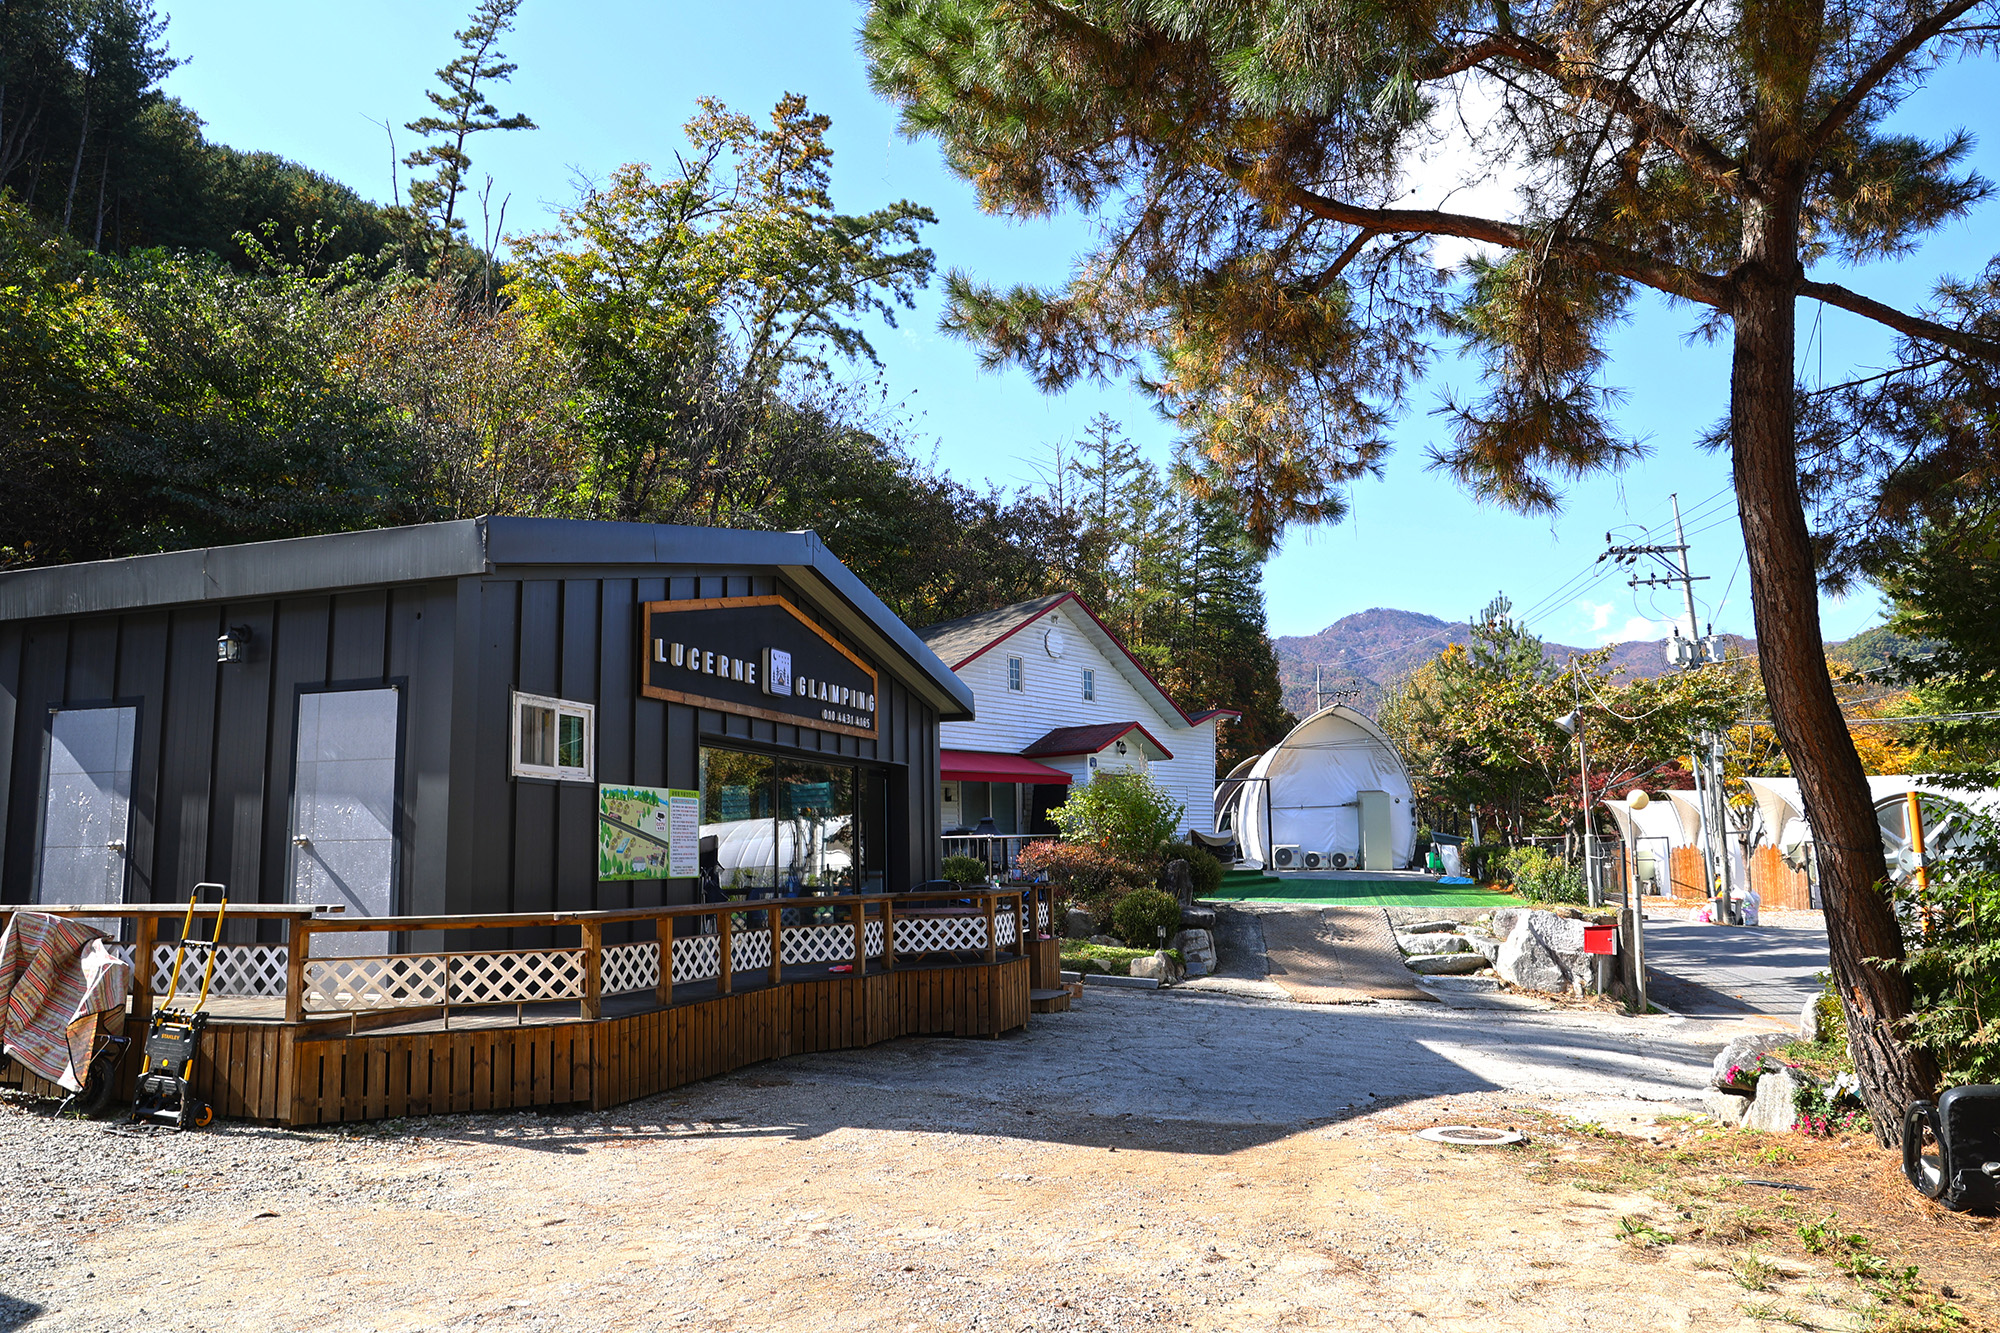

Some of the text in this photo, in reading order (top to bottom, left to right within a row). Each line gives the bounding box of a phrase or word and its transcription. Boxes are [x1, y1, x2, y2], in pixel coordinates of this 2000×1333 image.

[654, 638, 875, 712] LUCERNE GLAMPING
[821, 709, 836, 721] 010
